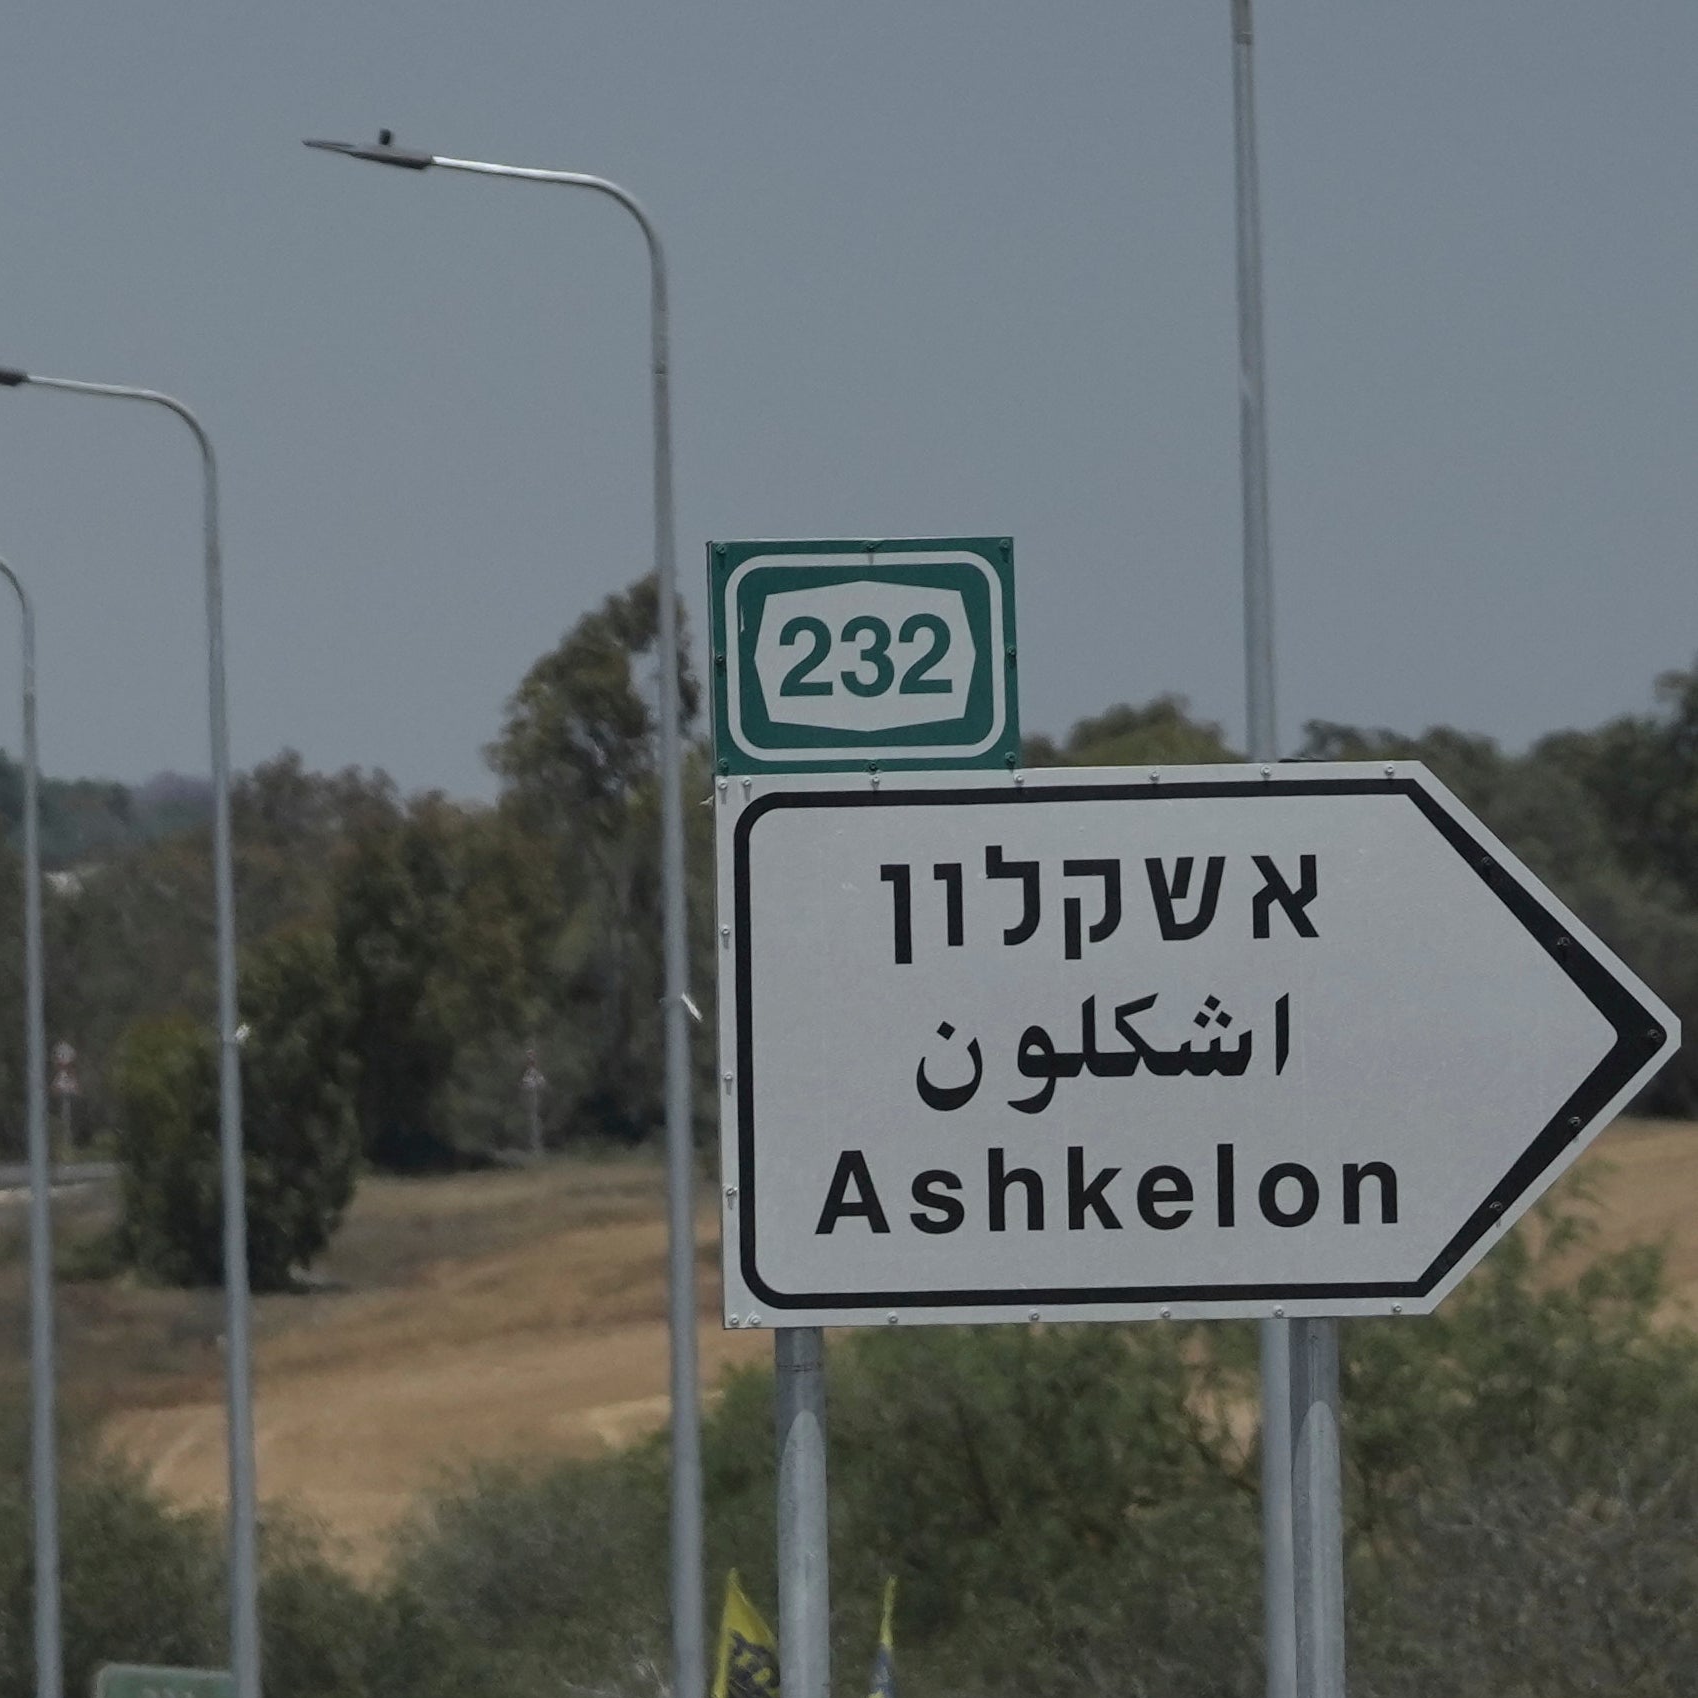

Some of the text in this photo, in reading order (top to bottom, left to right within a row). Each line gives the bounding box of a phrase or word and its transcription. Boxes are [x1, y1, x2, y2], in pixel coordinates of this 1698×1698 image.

[777, 613, 954, 698] 232
[880, 846, 1320, 965] אשקלון
[815, 1143, 1399, 1235] Ashkelon
